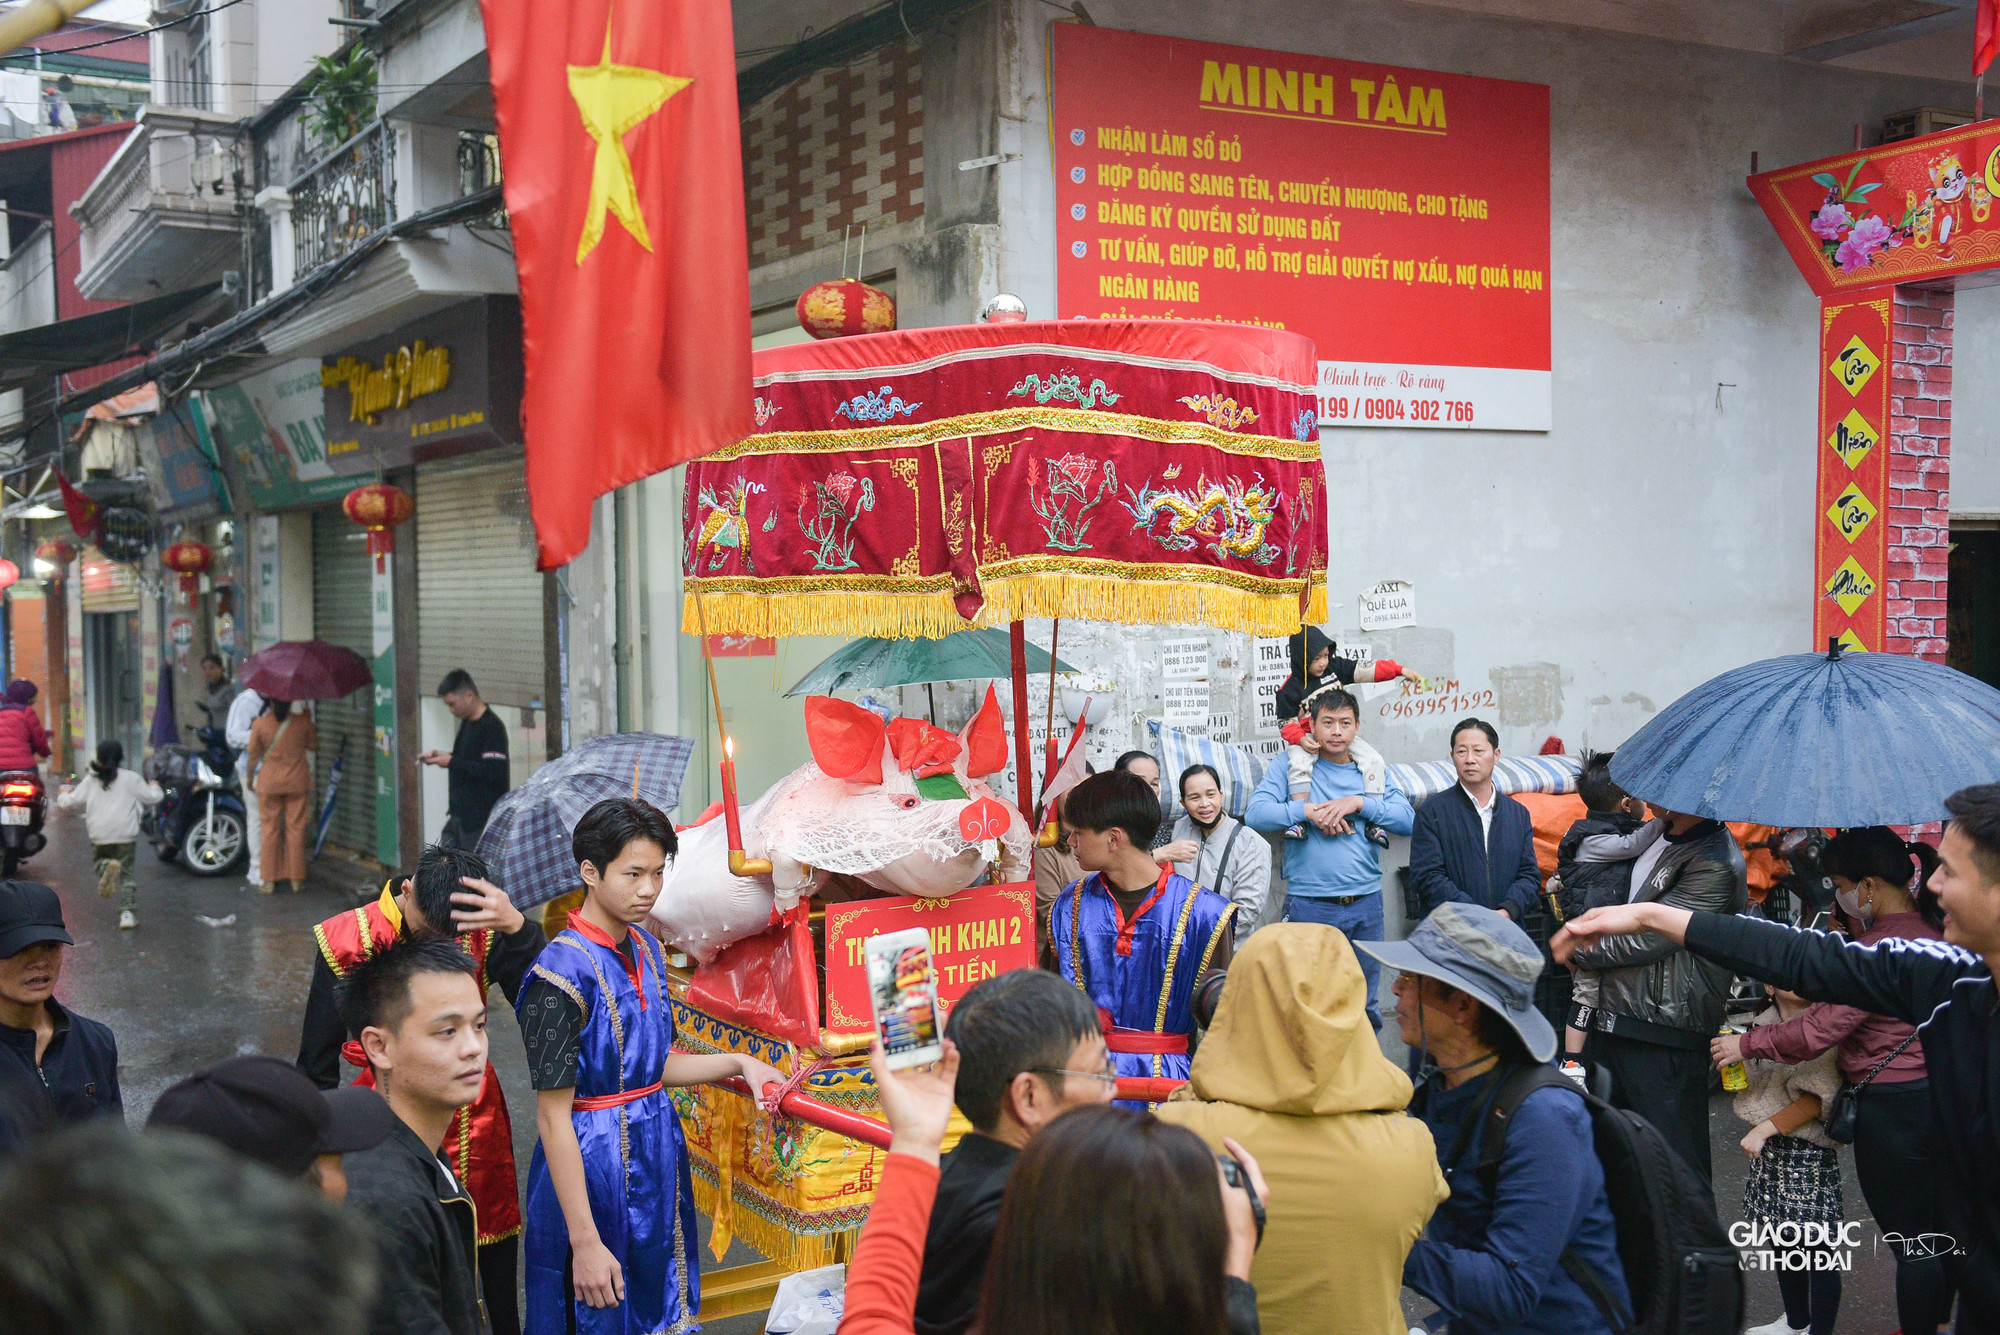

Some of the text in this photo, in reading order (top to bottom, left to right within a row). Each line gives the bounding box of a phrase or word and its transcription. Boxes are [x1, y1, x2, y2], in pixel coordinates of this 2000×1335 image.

[1200, 60, 1447, 129] MINH TÂM
[1097, 125, 1242, 163] NHẬN LÀM SỔ ĐỎ
[1098, 162, 1488, 222] HỢP ĐỒNG SANG TÊN, CHUYỂN NHƯỢNG, CHO TẶNG
[1098, 198, 1341, 242] ĐĂNG KÝ QUYỀN SỬ DỤNG ĐẤT
[1098, 234, 1543, 294] TƯ VẤN, GIÚP ĐỠ, HỖ TRỢ GIẢI QUYẾT NỢ XẤU, NỢ QUÁ HẠN
[1099, 272, 1200, 303] NGÂN HÀNG
[1840, 347, 1871, 386] Tân
[1418, 374, 1446, 393] ràng
[1365, 398, 1405, 420] 0904
[1410, 400, 1440, 421] 302
[1445, 401, 1474, 422] 766
[1836, 421, 1873, 466] Niên
[1837, 494, 1869, 534] Tân
[1367, 598, 1407, 612] QUÊ LỤA
[1163, 645, 1173, 654] CHO
[1173, 645, 1181, 653] VAY
[1192, 643, 1207, 652] NHANH
[1164, 655, 1207, 666] 0886 123 000
[1260, 640, 1282, 660] TRẢ
[1344, 648, 1368, 659] VAY
[1165, 687, 1174, 696] CHO
[1175, 687, 1183, 696] VAY
[1194, 687, 1209, 696] NHANH
[1165, 700, 1181, 708] 0886
[1380, 689, 1496, 720] 0969951592
[1213, 715, 1229, 727] VAY
[1260, 703, 1277, 717] TR
[1186, 722, 1207, 735] CHÍNH
[957, 918, 1005, 952] KHAI
[1010, 916, 1021, 945] 2
[944, 955, 996, 986] TIẾN
